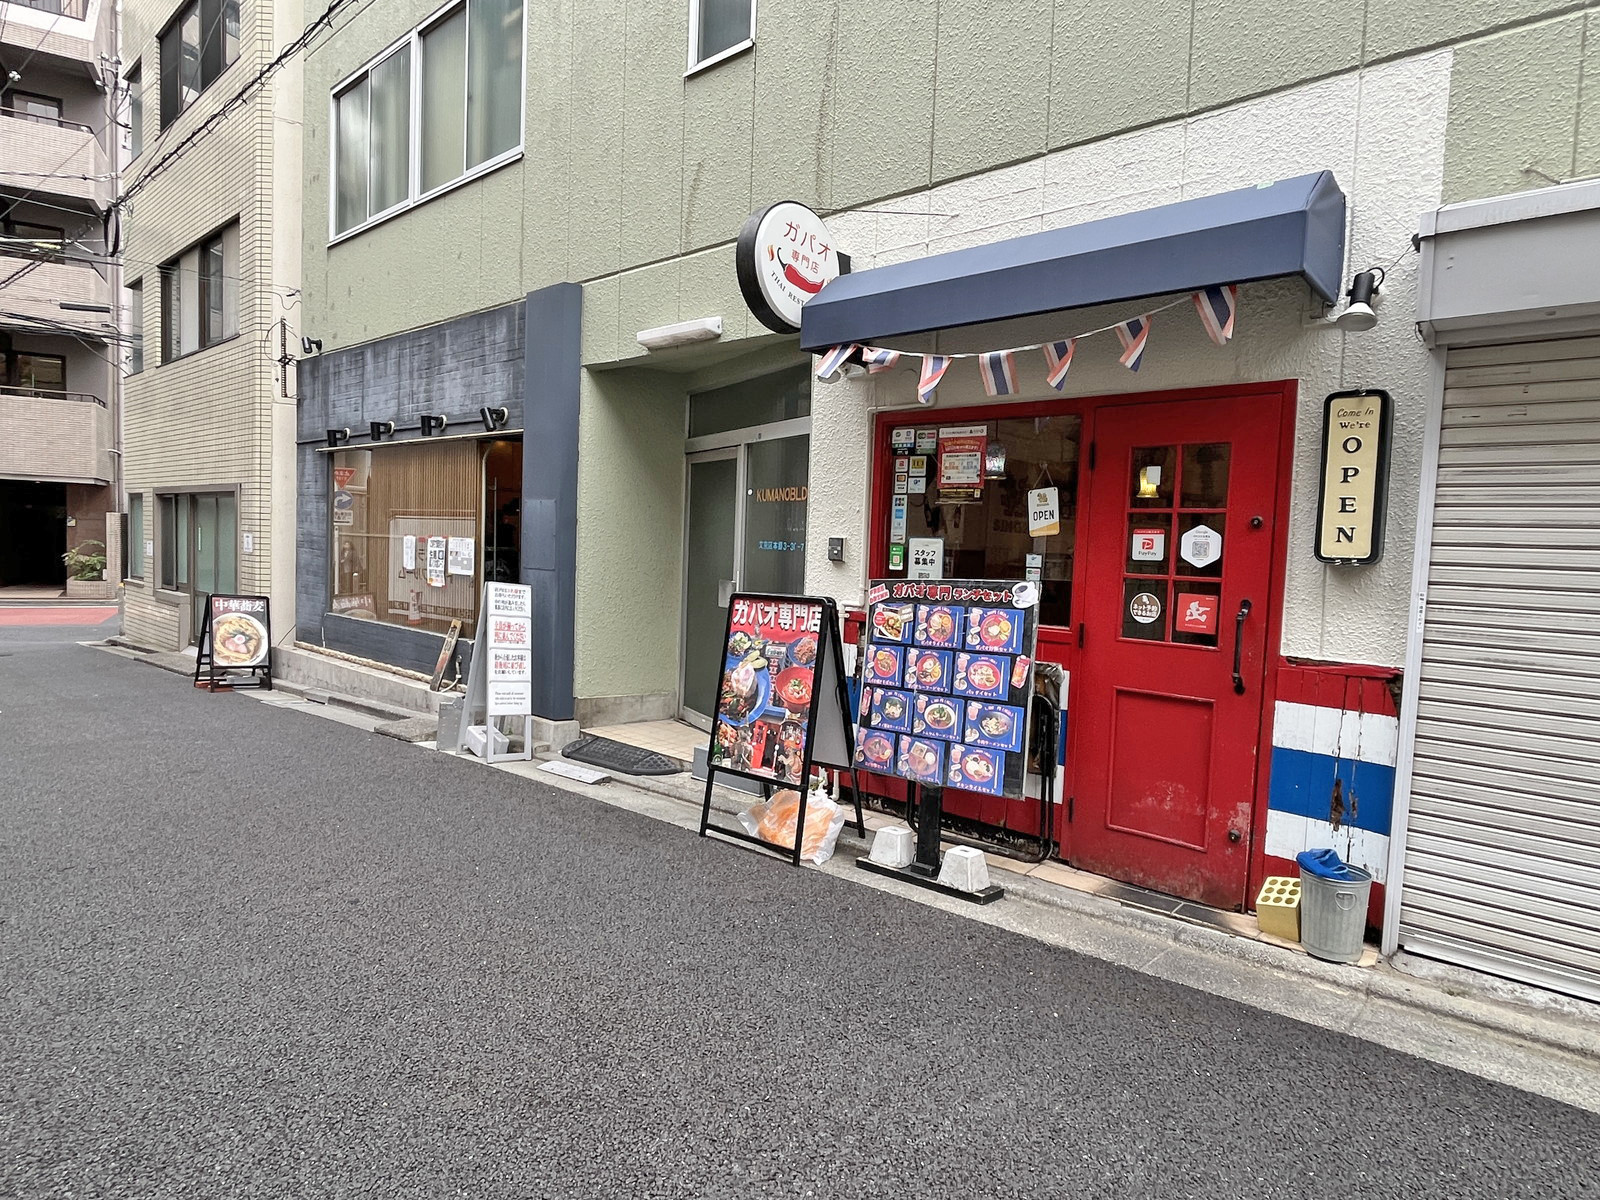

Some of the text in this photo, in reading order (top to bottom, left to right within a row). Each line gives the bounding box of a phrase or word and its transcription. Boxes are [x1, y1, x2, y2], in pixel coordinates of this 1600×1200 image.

[784, 221, 832, 262] ガパオ
[791, 249, 820, 274] 専門店
[771, 270, 787, 292] THAI
[1337, 407, 1374, 418] Come In
[1339, 421, 1371, 430] We're
[1335, 436, 1363, 543] OPEN
[1033, 509, 1055, 521] OPEN
[914, 557, 936, 566] 募集中
[893, 583, 1013, 602] ガパオ専門 ランチセット
[215, 599, 264, 612] 中華蕎麦
[733, 600, 822, 632] ガパオ専門店
